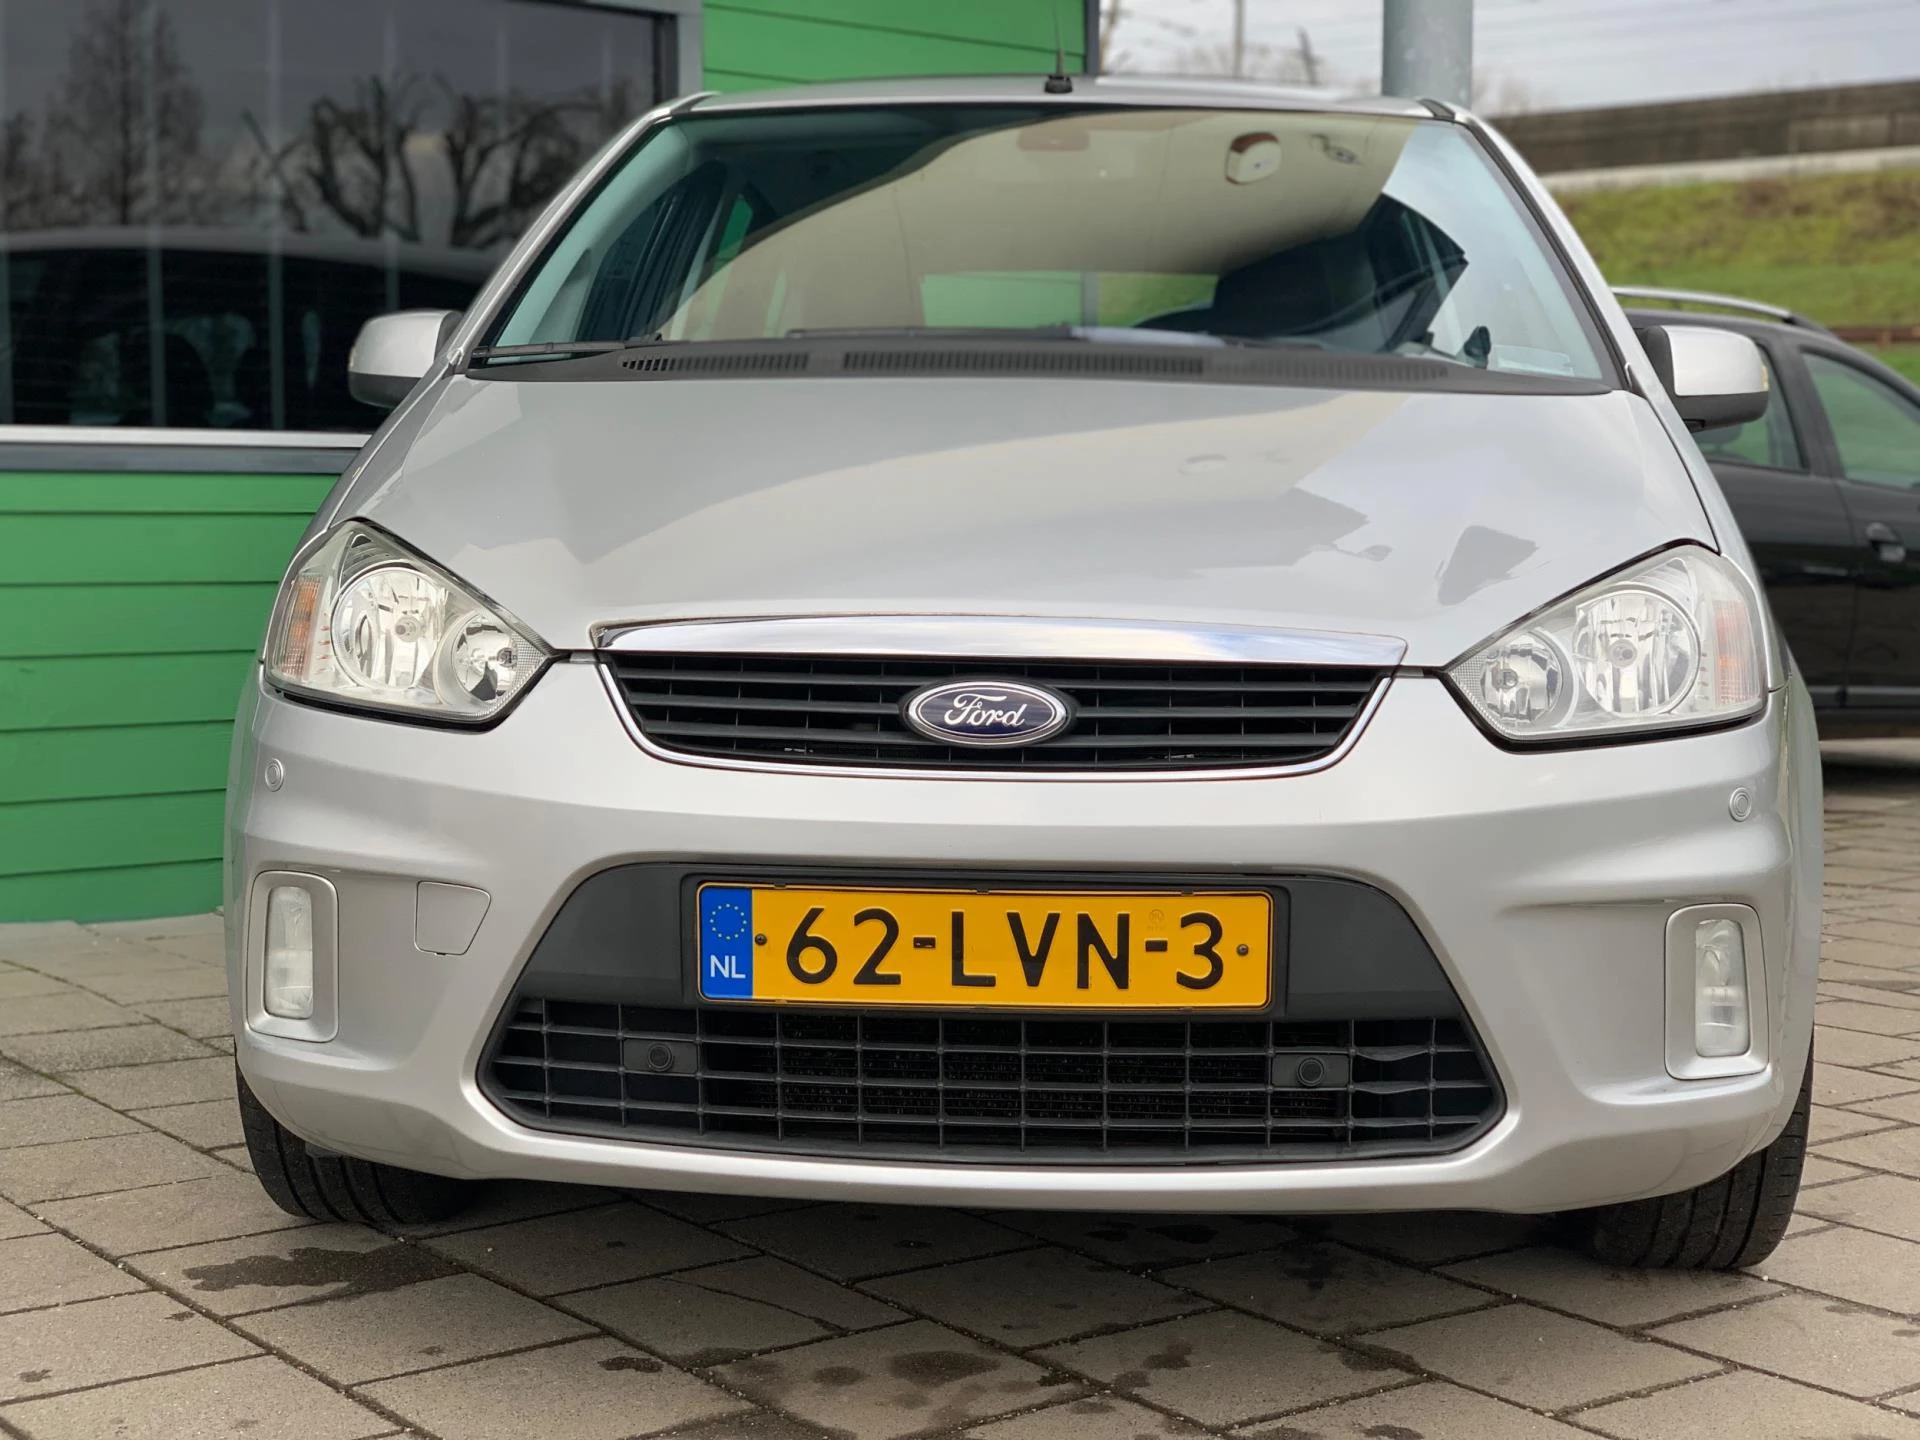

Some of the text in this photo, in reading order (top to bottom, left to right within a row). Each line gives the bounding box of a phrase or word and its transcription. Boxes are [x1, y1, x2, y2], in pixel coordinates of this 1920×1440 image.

[944, 693, 1028, 727] Ford
[786, 907, 1224, 990] 62-LVN-3
[710, 955, 746, 979] NL
